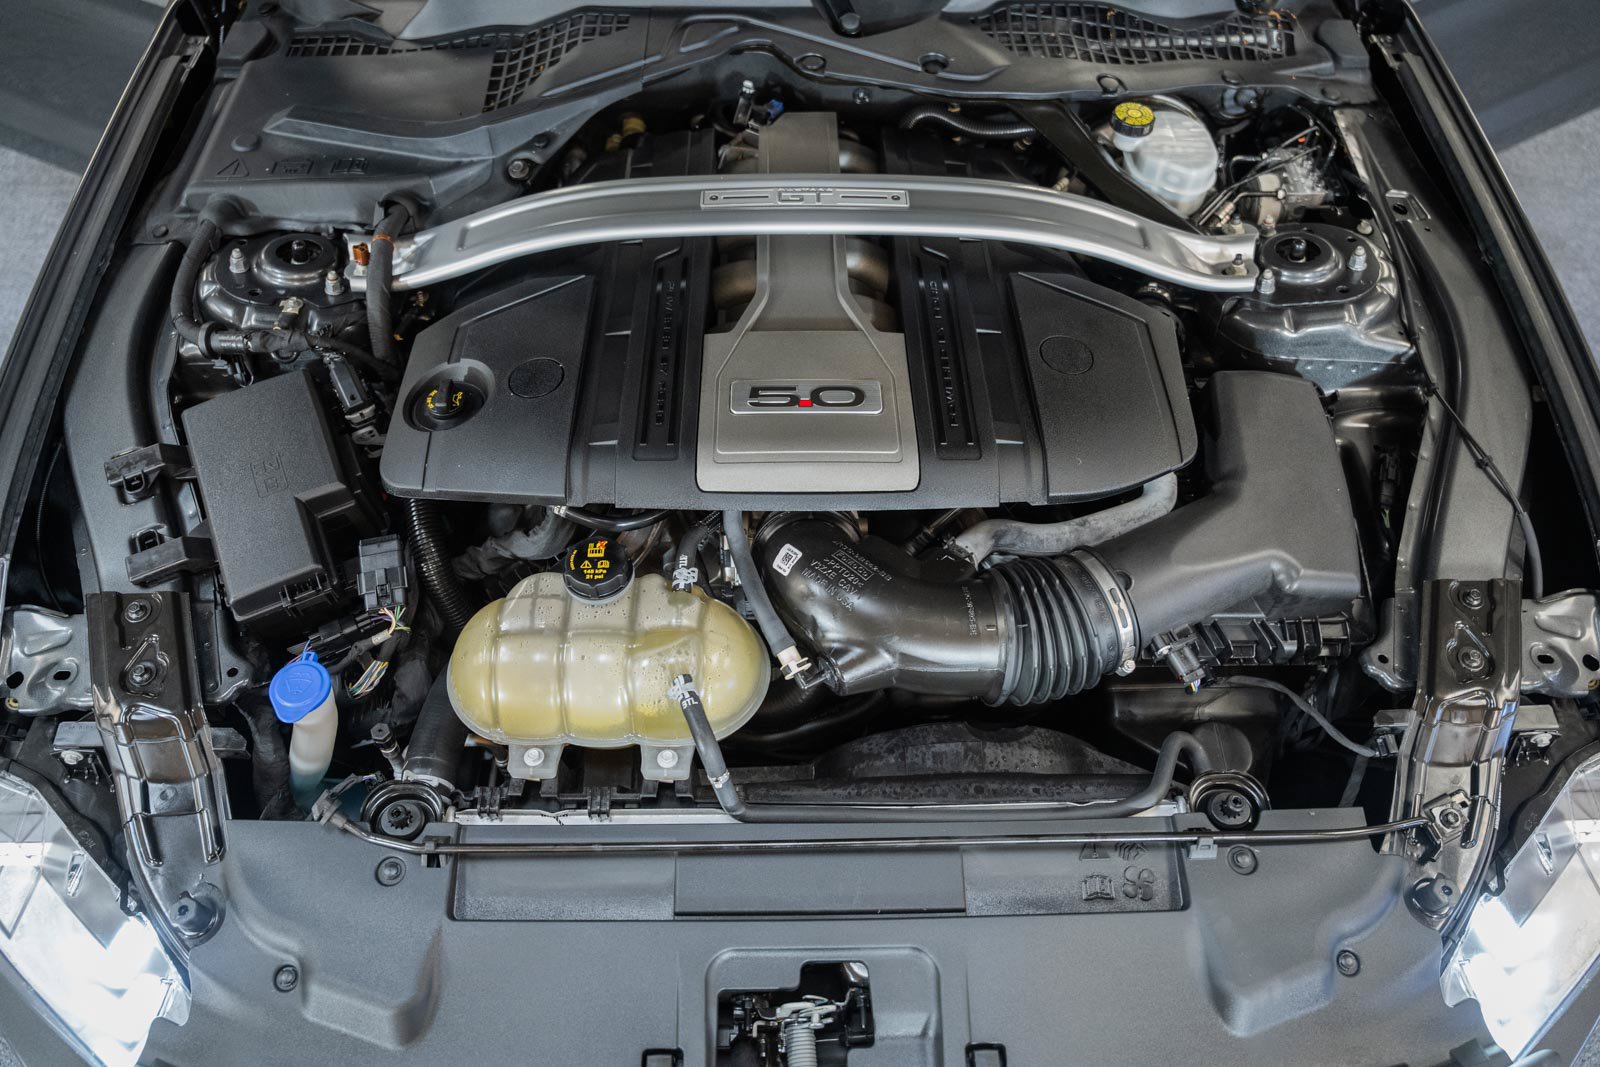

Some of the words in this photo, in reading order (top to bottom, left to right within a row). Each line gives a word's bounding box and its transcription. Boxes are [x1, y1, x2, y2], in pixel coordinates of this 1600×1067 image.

[777, 191, 833, 205] GT
[747, 385, 865, 408] 5.0
[826, 584, 838, 595] IN
[839, 579, 858, 595] CAV
